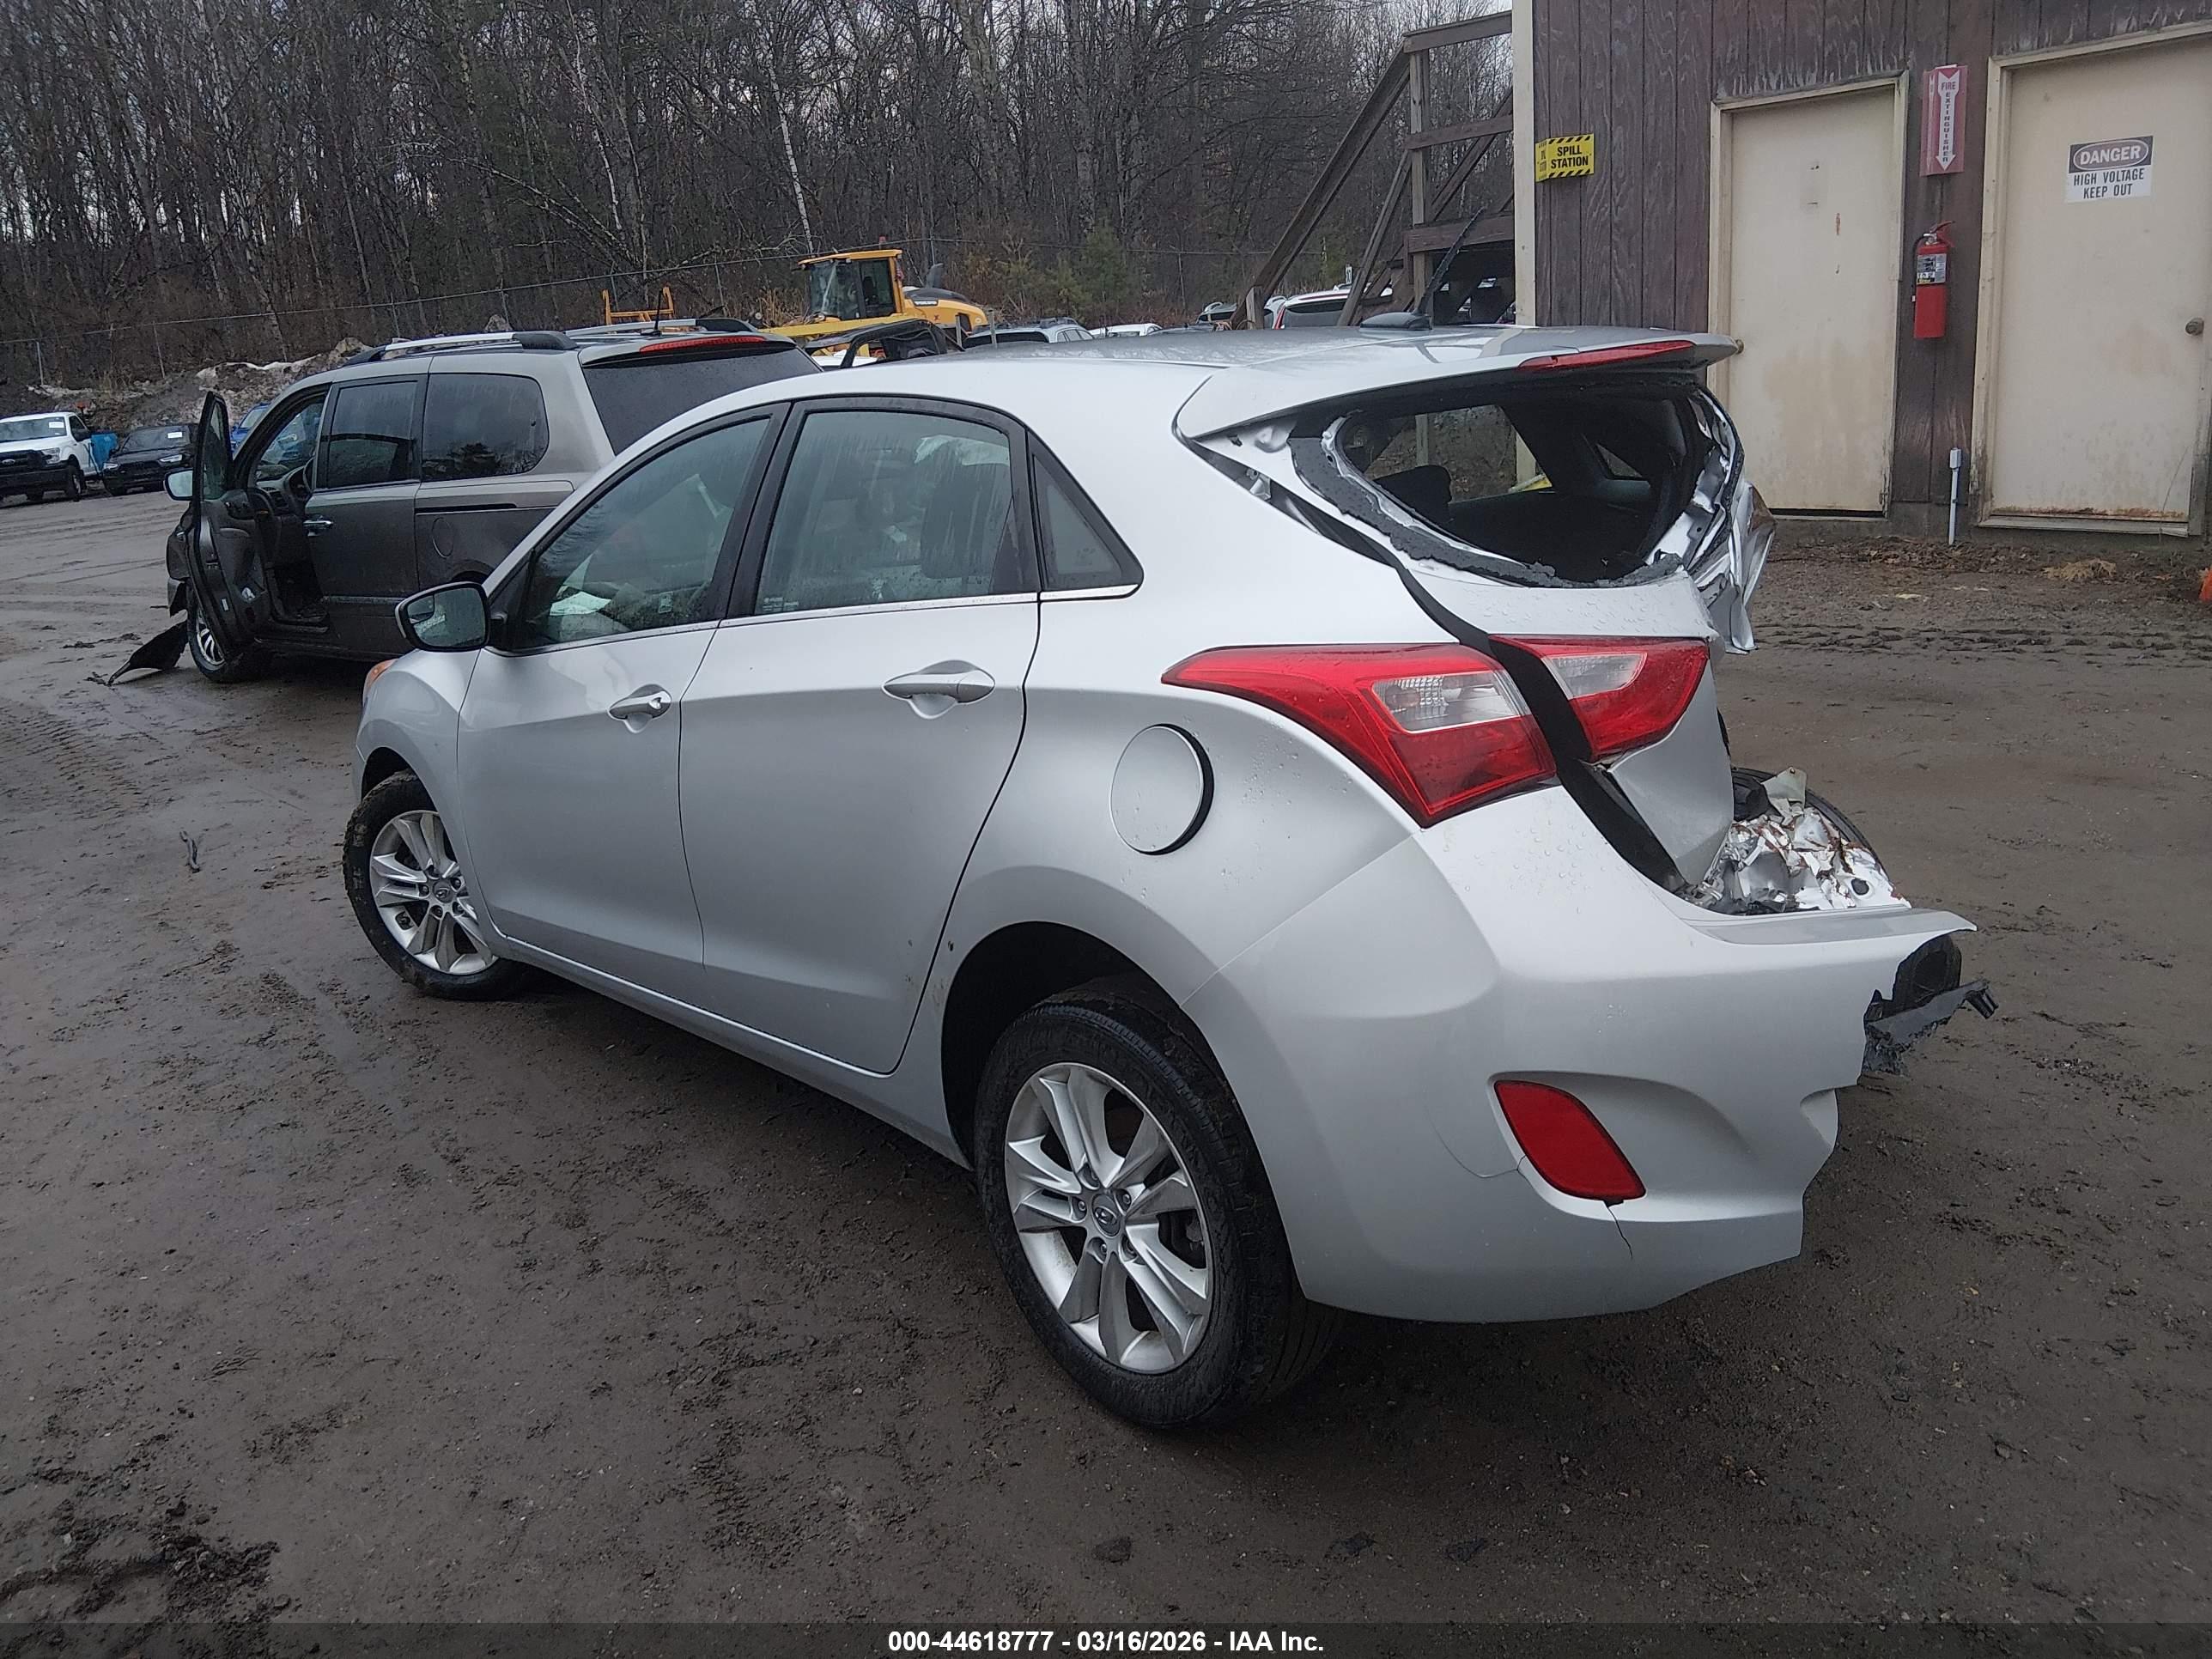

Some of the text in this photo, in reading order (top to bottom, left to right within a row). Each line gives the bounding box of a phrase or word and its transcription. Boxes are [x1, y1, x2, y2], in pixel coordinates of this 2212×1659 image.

[1941, 82, 1956, 90] FIRE
[1942, 91, 1951, 162] EXTINGUISHER
[1557, 145, 1582, 156] SPILL
[2080, 145, 2142, 165] DANGER
[1551, 155, 1589, 168] STATION
[2074, 167, 2145, 185] HIGH VOLTAGE
[2083, 183, 2133, 199] KEEP OUT
